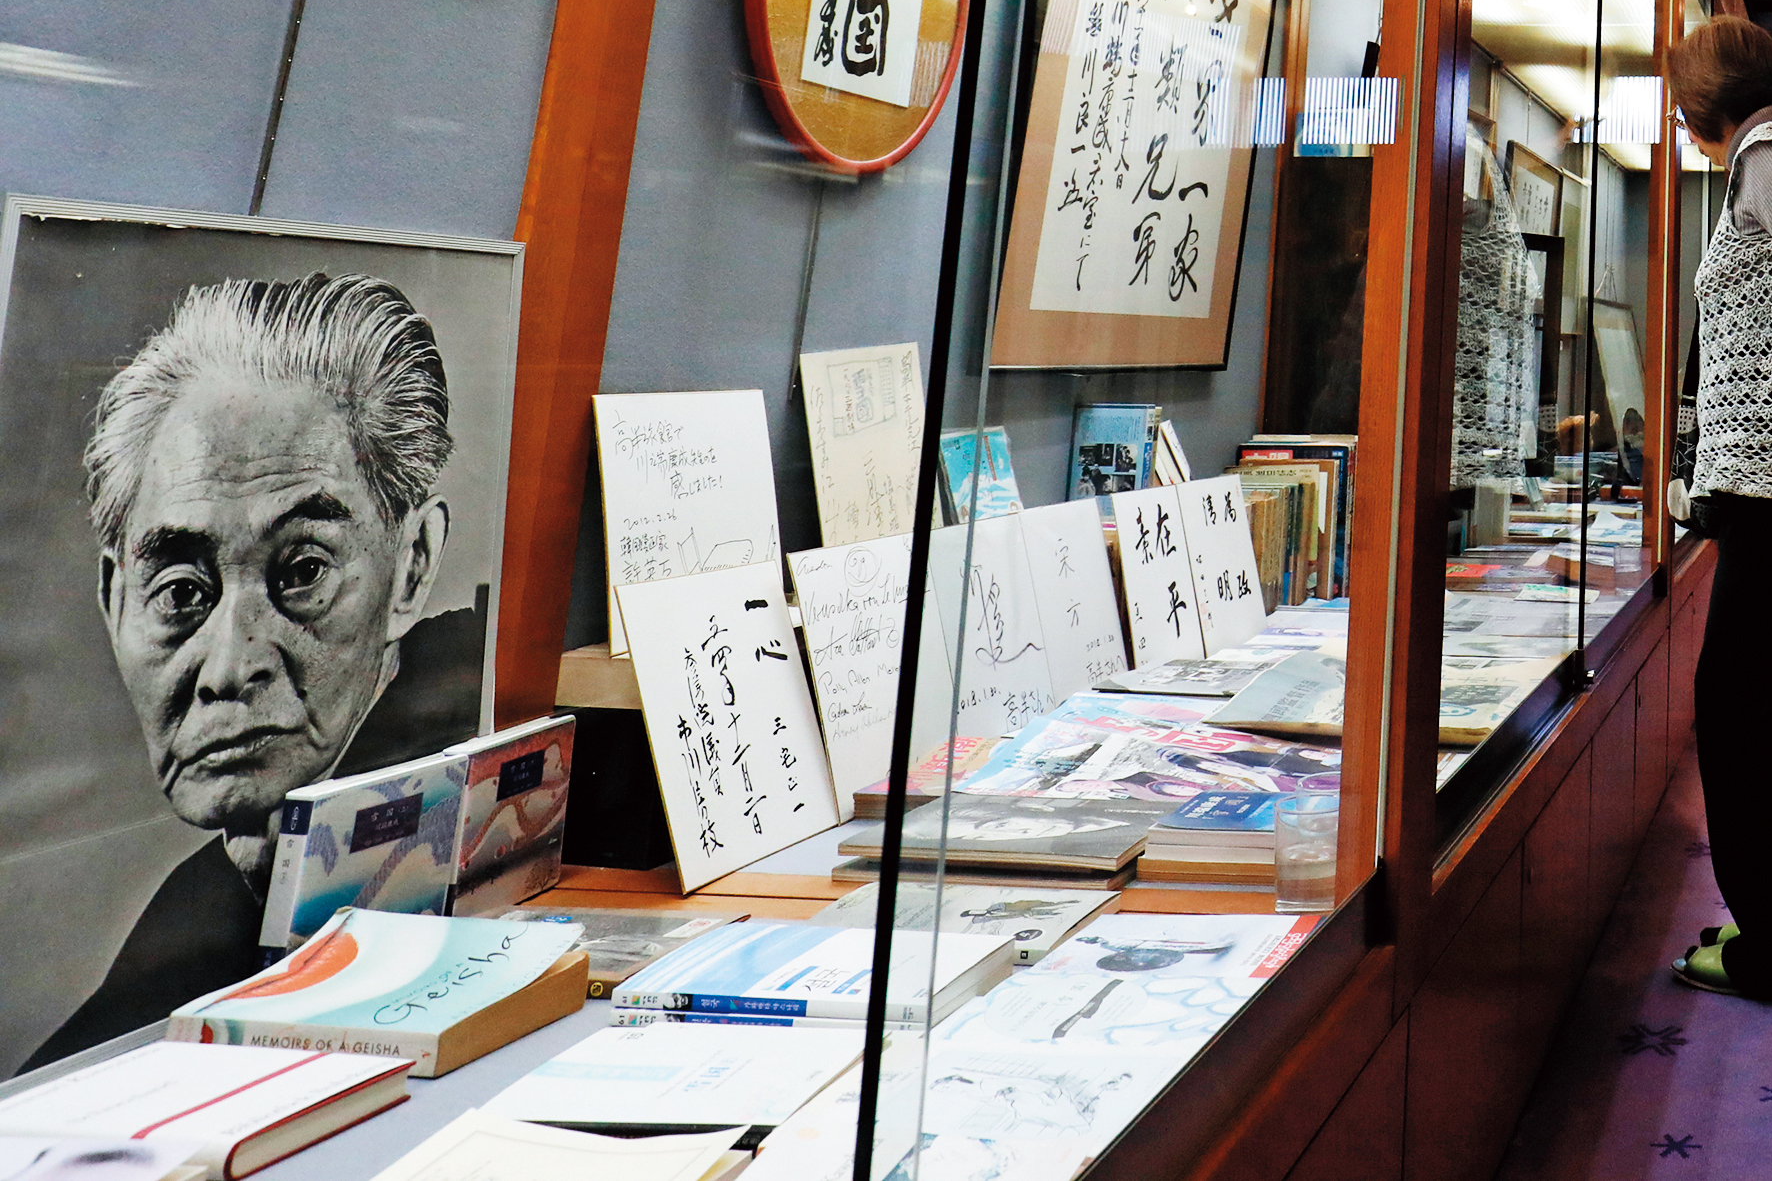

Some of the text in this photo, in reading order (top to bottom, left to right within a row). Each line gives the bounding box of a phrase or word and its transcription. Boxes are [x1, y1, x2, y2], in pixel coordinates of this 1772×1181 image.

[744, 599, 788, 662] 一心
[373, 922, 529, 1026] Geisha
[250, 1034, 401, 1057] MEMOIRS OF A GEISHA
